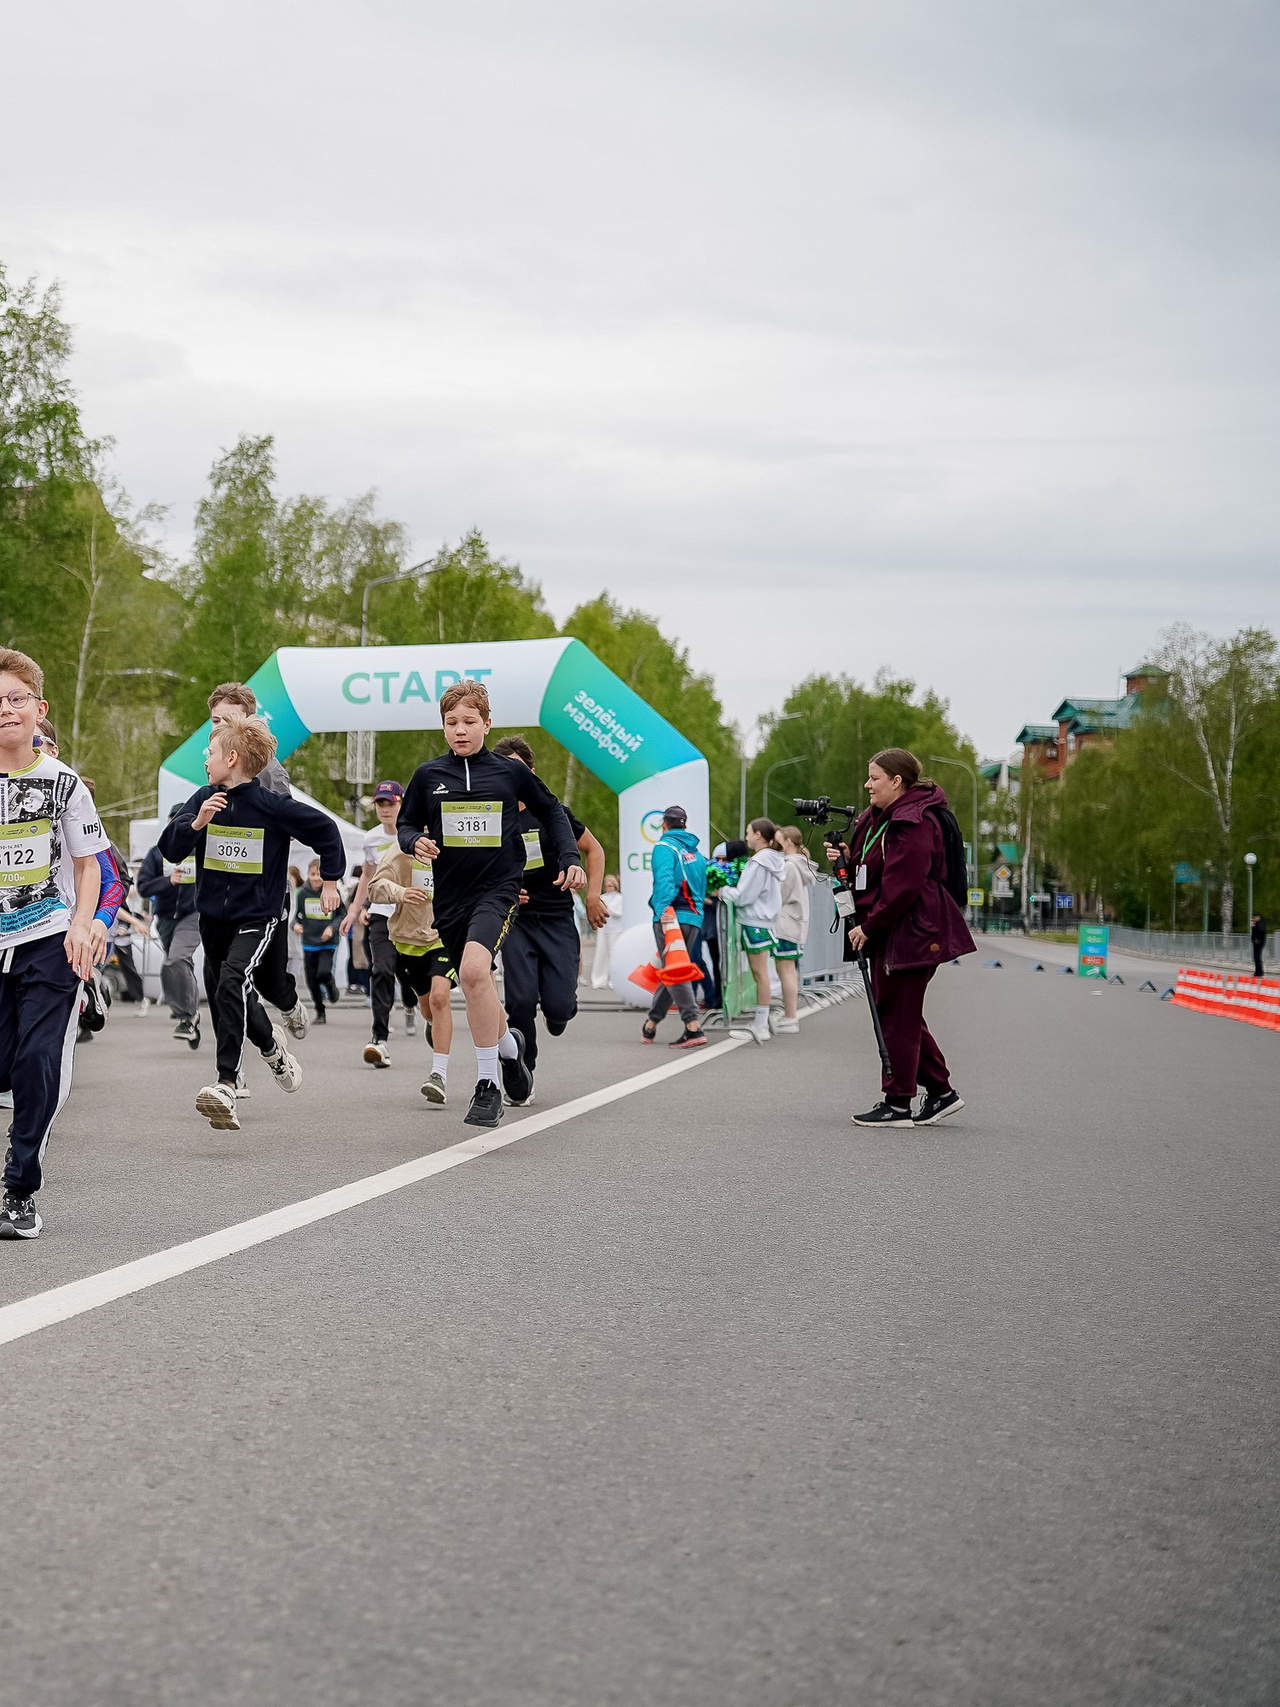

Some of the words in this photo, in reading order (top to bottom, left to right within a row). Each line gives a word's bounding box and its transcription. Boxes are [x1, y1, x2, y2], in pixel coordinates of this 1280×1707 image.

[574, 690, 644, 752] зелёный
[563, 702, 629, 764] марафон
[457, 820, 487, 832] 3181
[217, 845, 248, 858] 3096
[224, 861, 240, 869] 700м
[2, 873, 25, 882] 700м
